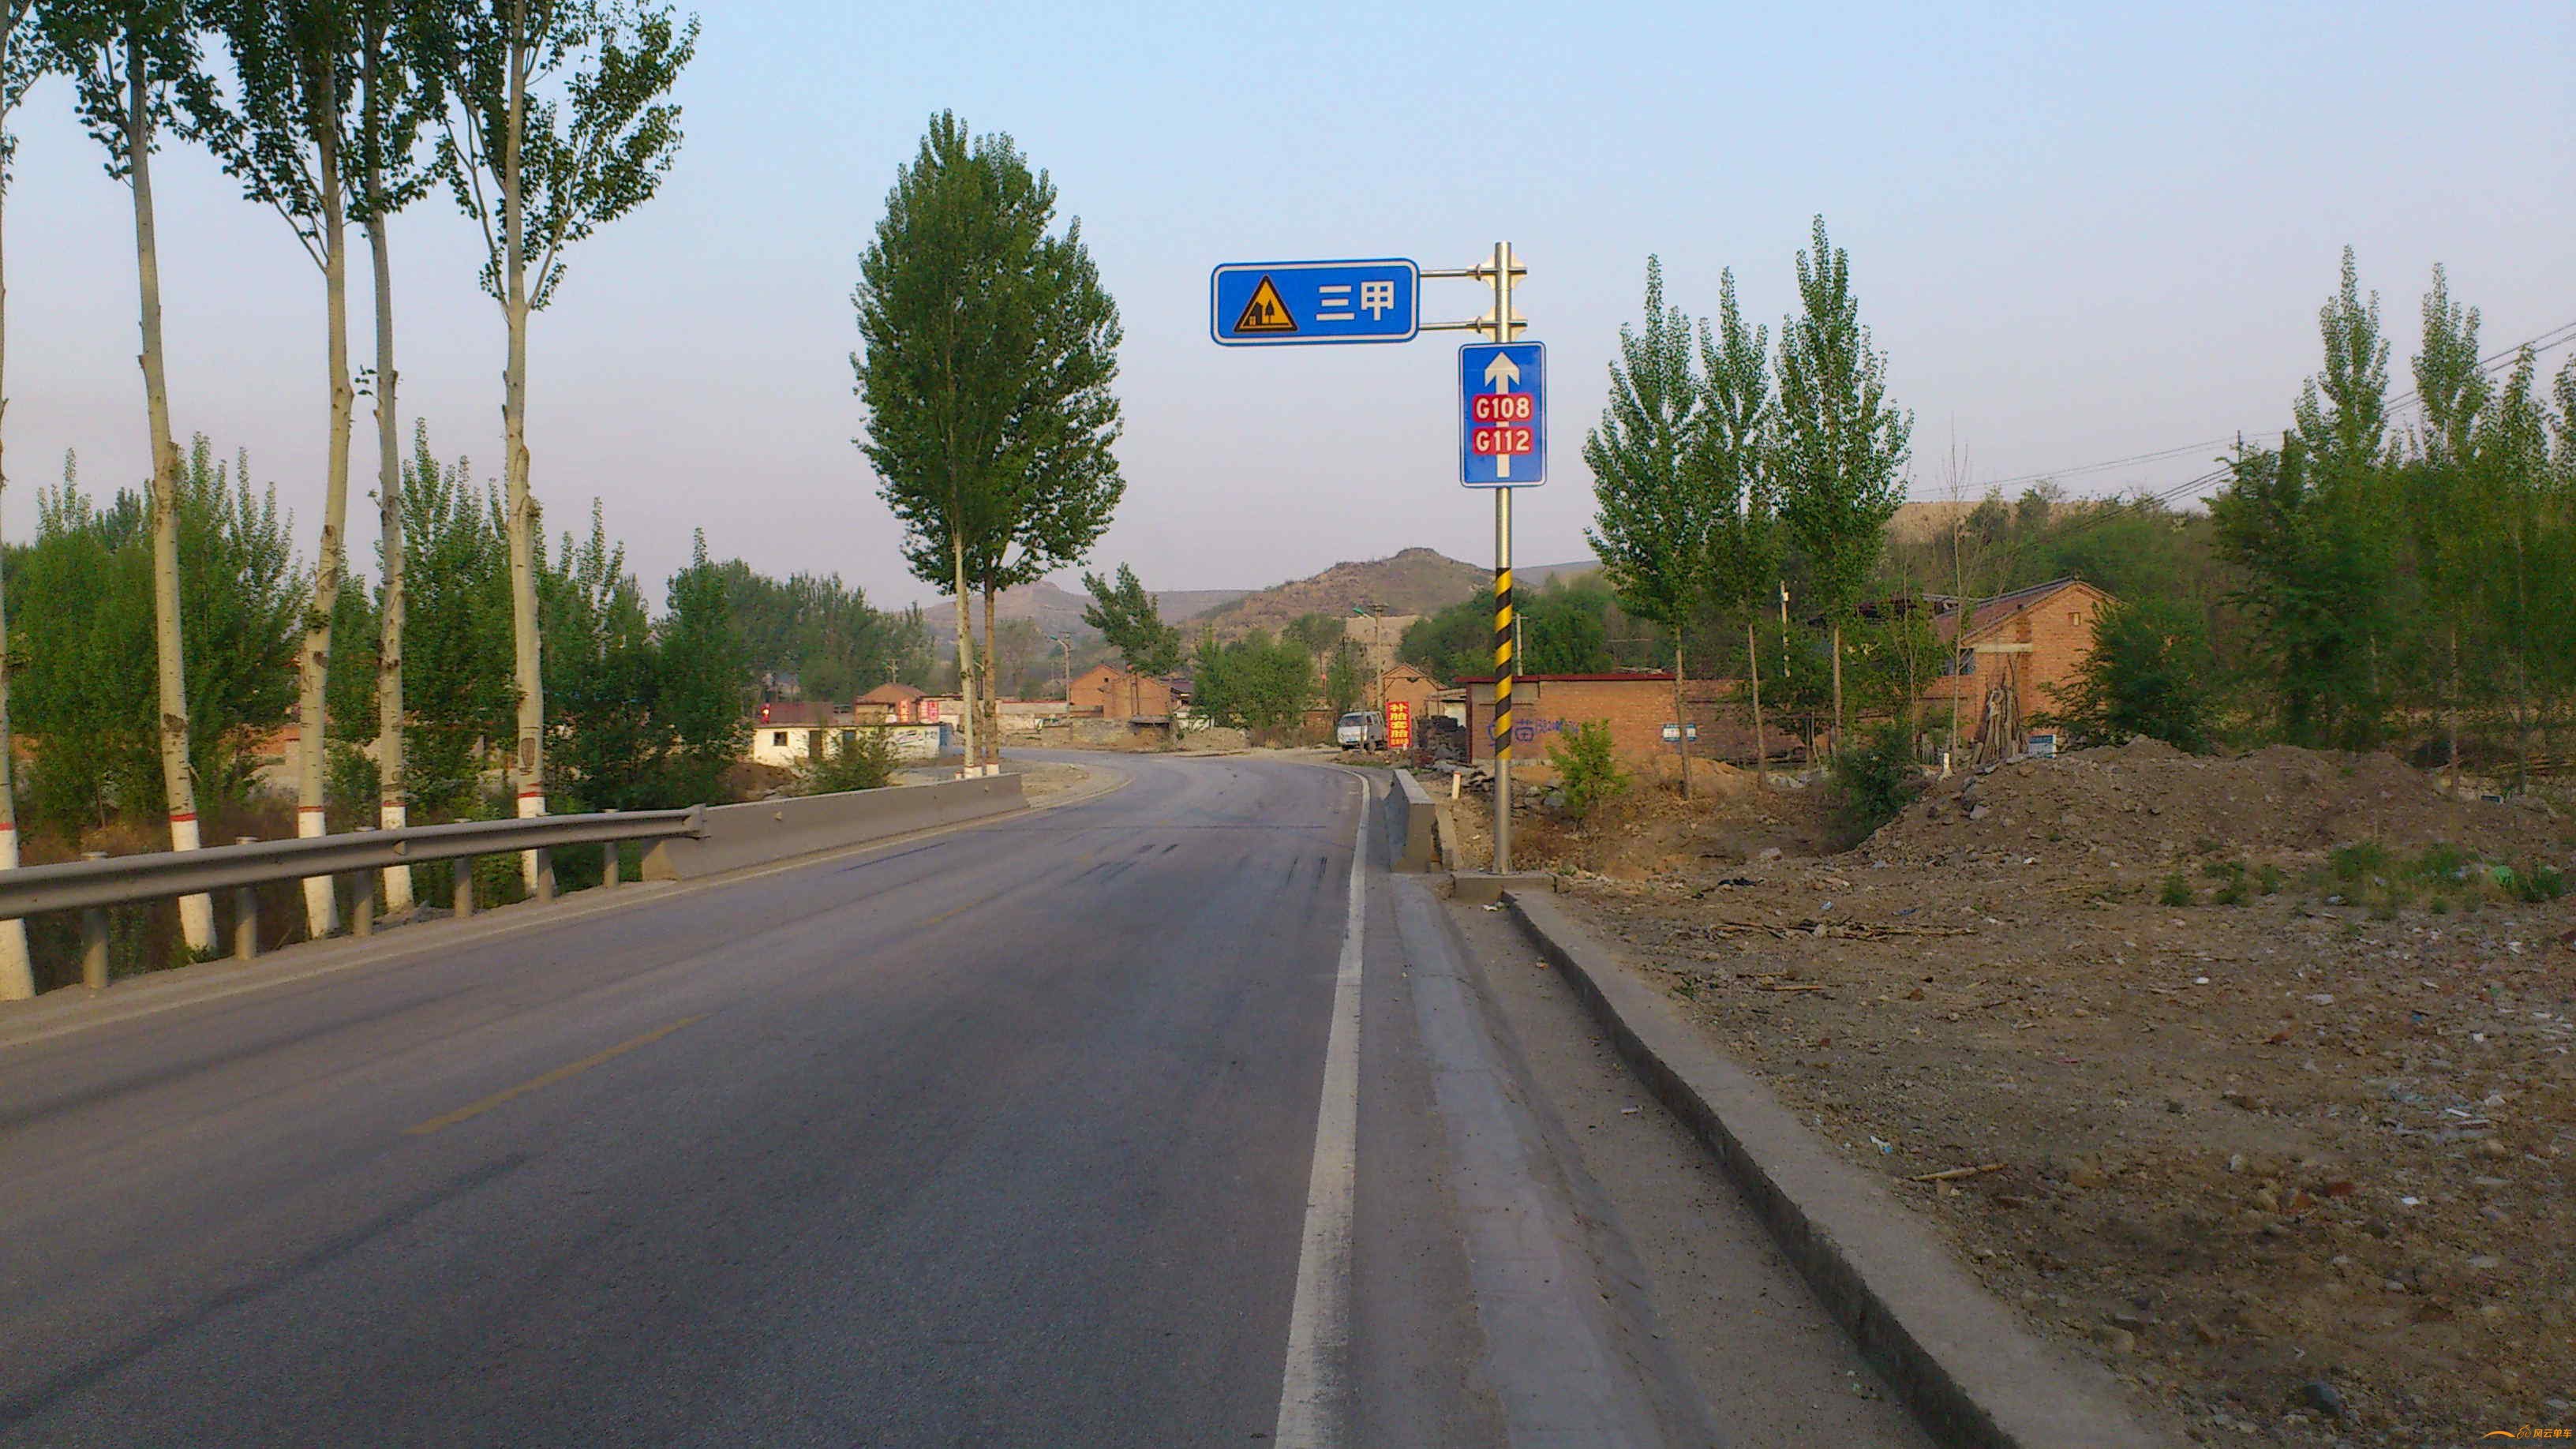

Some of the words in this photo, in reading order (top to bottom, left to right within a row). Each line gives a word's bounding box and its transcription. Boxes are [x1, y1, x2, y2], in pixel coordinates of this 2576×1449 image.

[1316, 281, 1395, 321] 三甲
[1476, 397, 1530, 419] G108
[1476, 429, 1530, 452] G112
